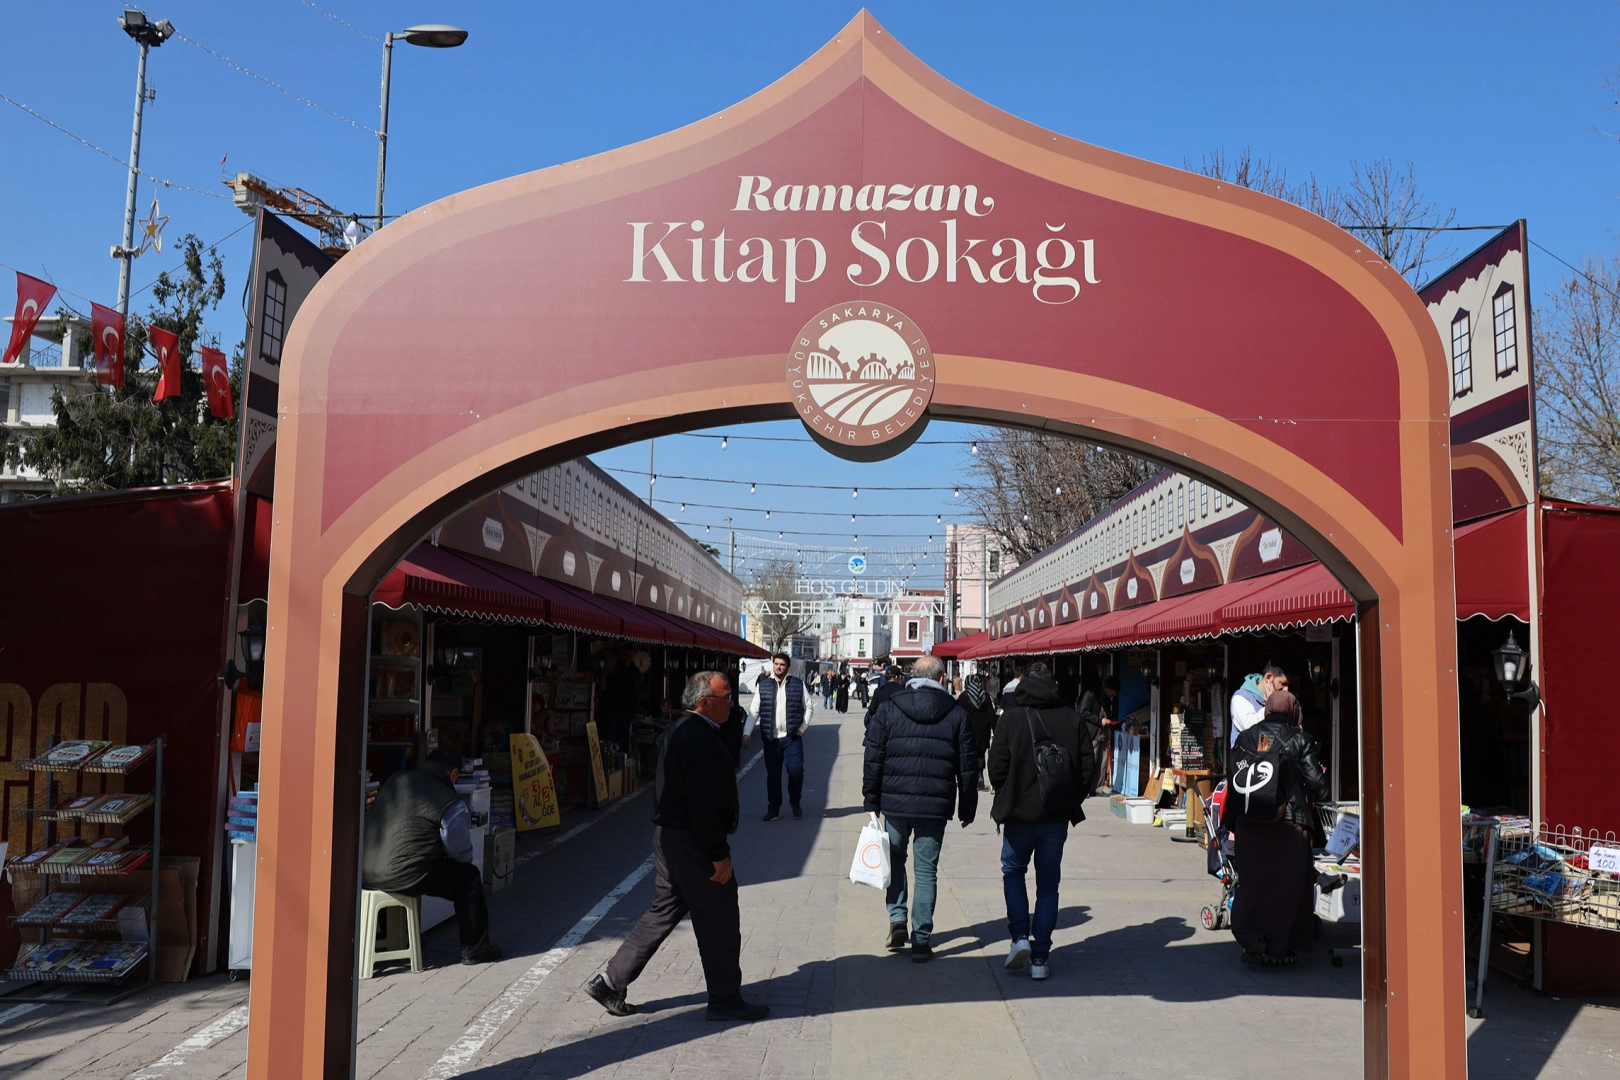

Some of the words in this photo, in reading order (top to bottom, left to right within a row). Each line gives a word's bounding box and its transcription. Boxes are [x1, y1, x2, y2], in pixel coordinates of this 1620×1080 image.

[731, 175, 995, 217] Ramazan
[622, 218, 828, 304] Kitap
[845, 217, 1102, 305] Sokağı
[819, 306, 904, 331] SAKARYA
[792, 337, 857, 440] BÜYÜKŞEHİR
[797, 579, 836, 598] HOŞ
[748, 600, 772, 616] YA
[533, 780, 540, 796] 3
[543, 787, 550, 802] 2
[533, 795, 542, 808] AL
[541, 803, 555, 817] ÖDE
[1594, 848, 1602, 857] 4
